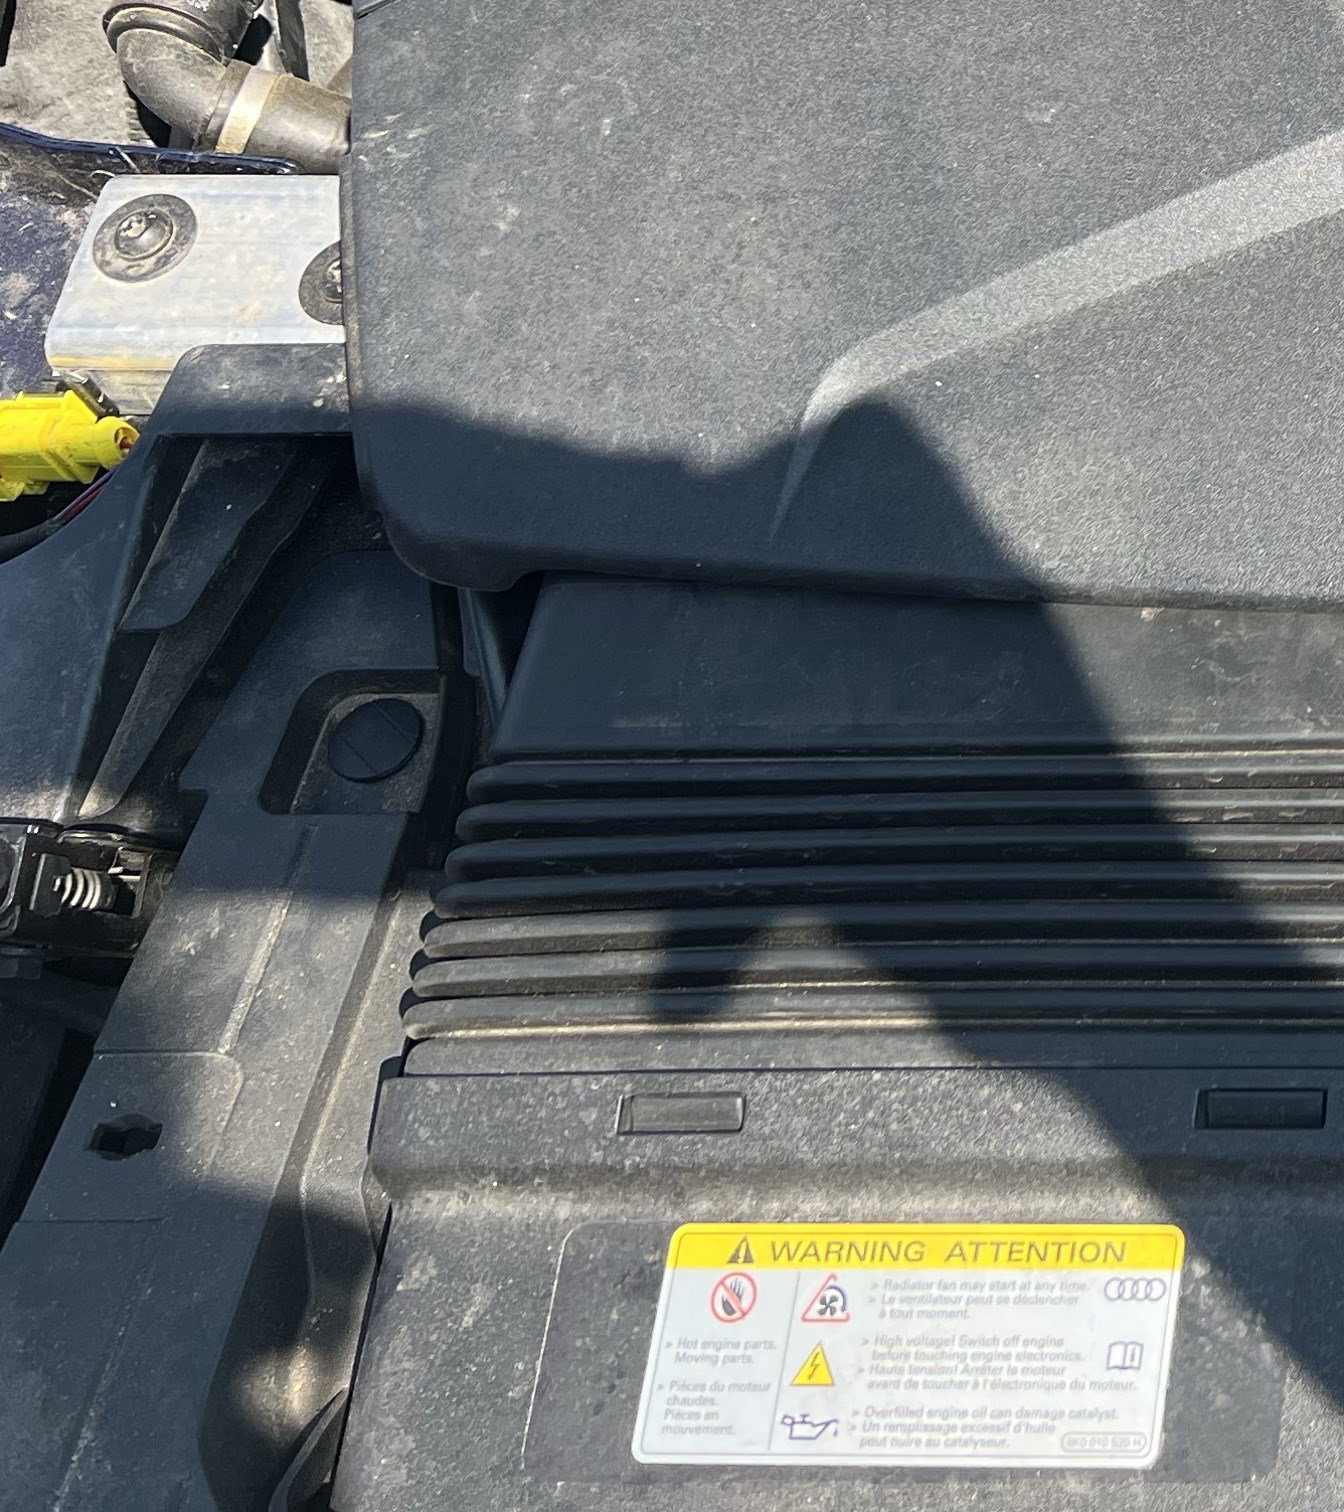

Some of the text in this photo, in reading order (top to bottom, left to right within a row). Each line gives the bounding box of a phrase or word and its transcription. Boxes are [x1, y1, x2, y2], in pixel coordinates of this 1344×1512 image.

[769, 1239, 1129, 1264] WARNING ATTENTION
[884, 1280, 935, 1291] Radiator
[938, 1279, 957, 1291] fan
[960, 1280, 987, 1293] may
[989, 1280, 1017, 1291] start
[1020, 1280, 1032, 1291] at
[1035, 1281, 1057, 1294] any
[882, 1295, 896, 1305] Le
[899, 1294, 963, 1305] ventilateur
[966, 1295, 993, 1307] peut
[996, 1296, 1010, 1305] se
[890, 1308, 914, 1319] tout
[916, 1309, 970, 1320] moment.
[677, 1338, 776, 1353] Hot engine parts.
[875, 1336, 903, 1350] High
[958, 1336, 1000, 1347] Switch
[1003, 1335, 1021, 1347] off
[1023, 1336, 1064, 1350] engine
[675, 1352, 755, 1365] Moving parts.
[871, 1350, 1084, 1364] before touching engine electronics.
[869, 1364, 905, 1375] Haute
[1007, 1364, 1018, 1375] le
[1023, 1365, 1066, 1376] moteur
[669, 1380, 772, 1392] Pièces du moteur
[867, 1379, 902, 1390] avant
[905, 1379, 919, 1389] de
[923, 1379, 969, 1390] toucher
[1070, 1379, 1085, 1390] du
[1088, 1380, 1137, 1391] moteur.
[667, 1396, 718, 1406] chaudes.
[664, 1409, 719, 1421] Pièces en
[864, 1407, 1119, 1421] Overfilled engine oil can damage catalyst.
[661, 1425, 736, 1436] mouvement.
[863, 1422, 880, 1433] Un
[883, 1422, 957, 1434] remplissage
[961, 1422, 1011, 1433] excessif
[859, 1436, 1010, 1450] peut nuire au catalyseur.
